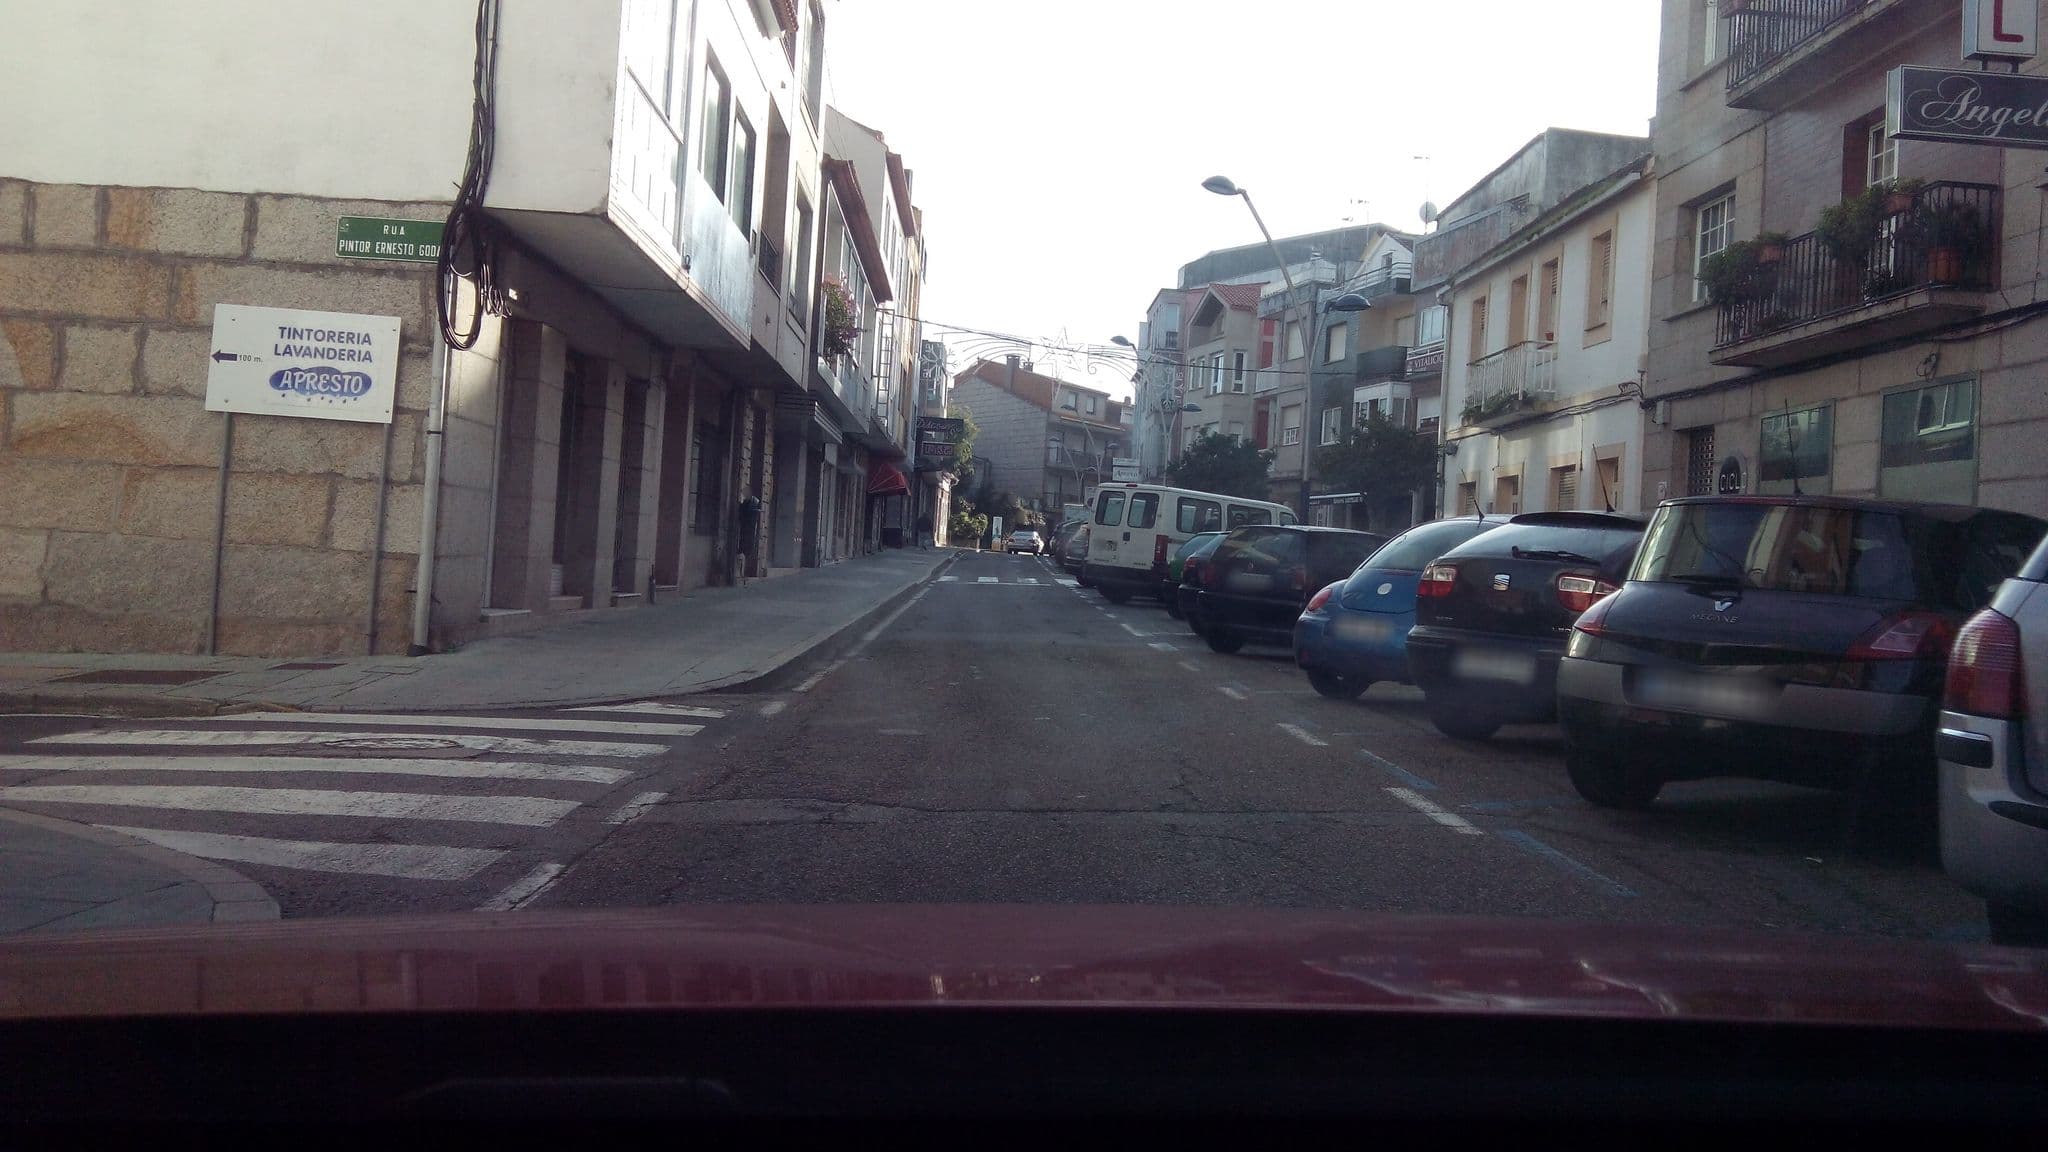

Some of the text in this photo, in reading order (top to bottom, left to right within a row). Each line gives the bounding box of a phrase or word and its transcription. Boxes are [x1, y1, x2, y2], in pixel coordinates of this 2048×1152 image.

[383, 224, 405, 235] RUA
[339, 239, 371, 253] PINTOR
[375, 241, 414, 256] ERNESTO
[278, 326, 372, 346] TINTORERIA
[238, 353, 252, 362] 100
[273, 343, 373, 363] LAVANDERIA
[279, 370, 363, 394] APRESTO
